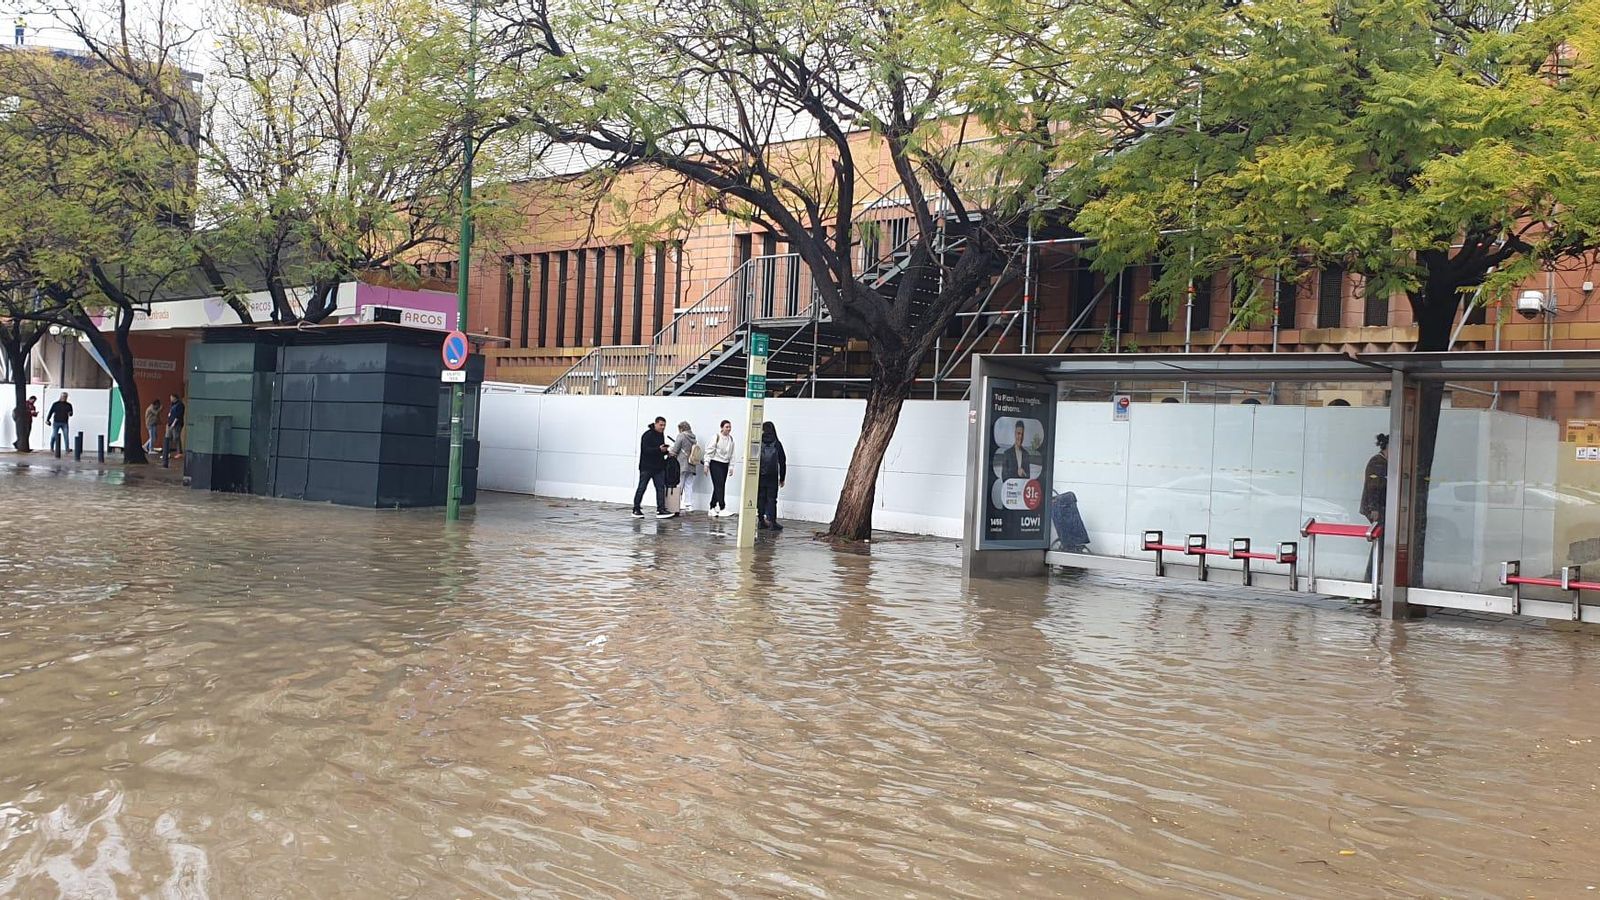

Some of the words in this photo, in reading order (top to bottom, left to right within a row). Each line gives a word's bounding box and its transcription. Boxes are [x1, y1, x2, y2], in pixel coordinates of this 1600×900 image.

[404, 312, 443, 326] ARCOS
[994, 393, 1002, 401] Tu
[994, 403, 1002, 411] Tu
